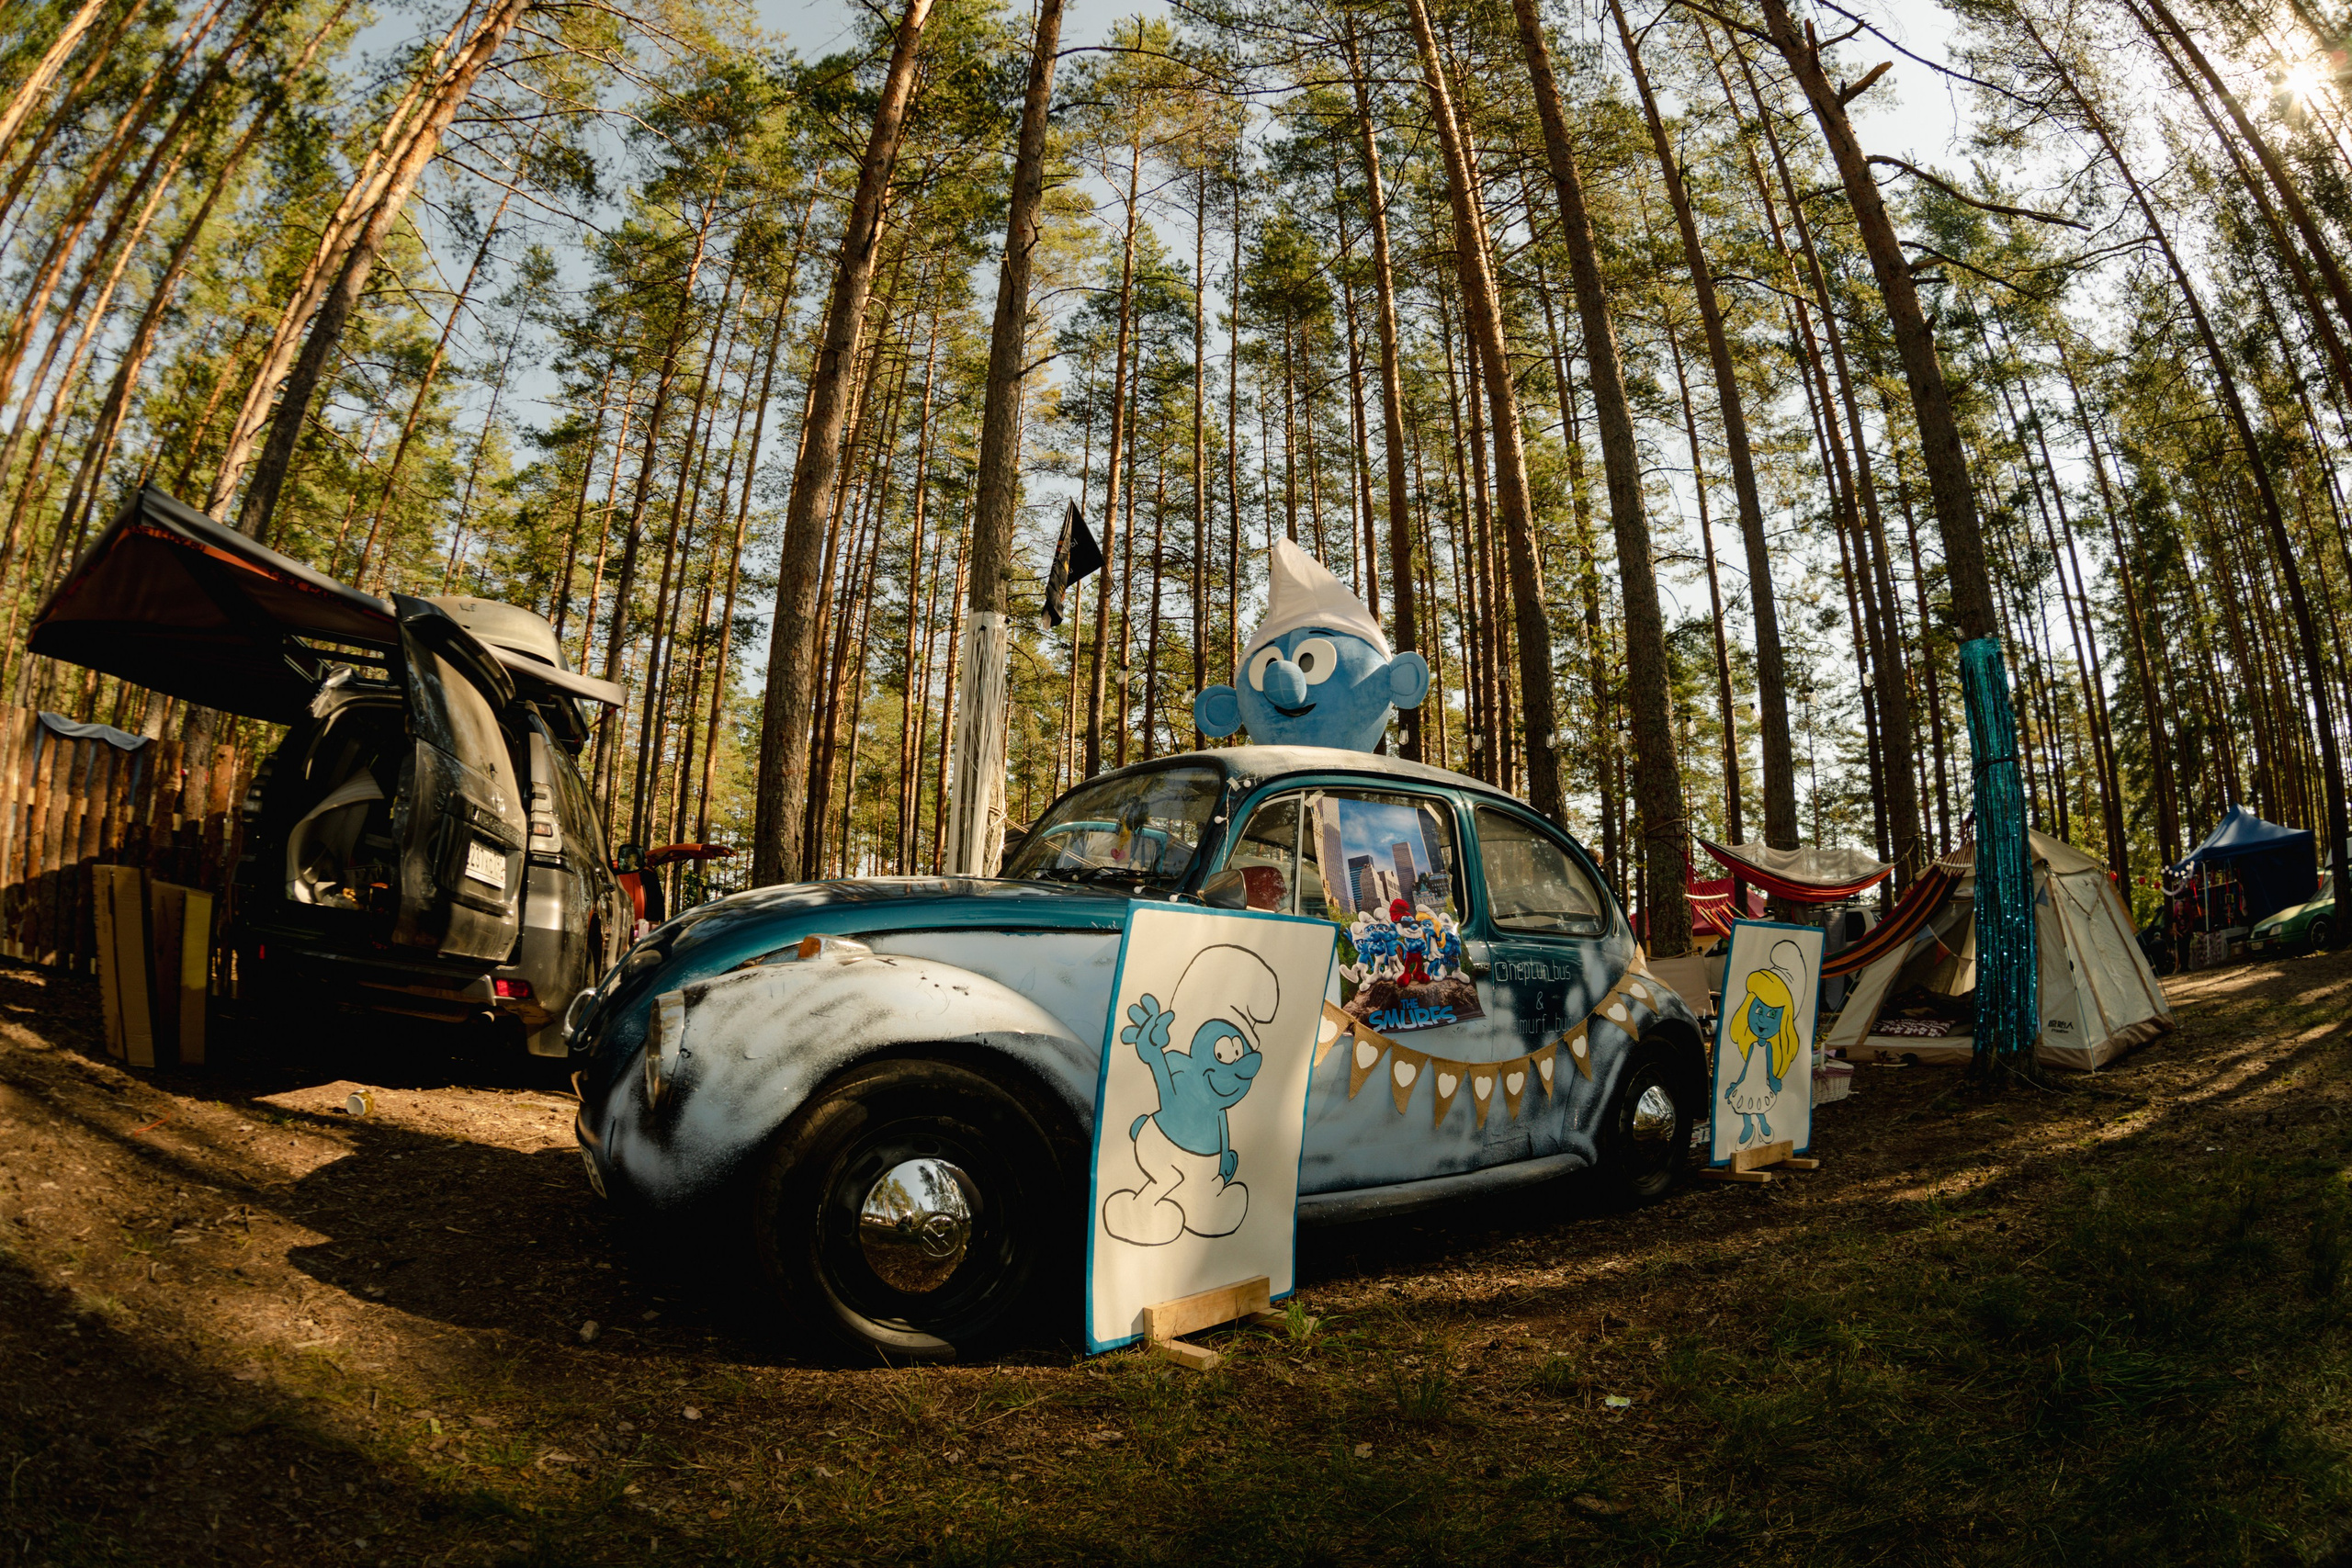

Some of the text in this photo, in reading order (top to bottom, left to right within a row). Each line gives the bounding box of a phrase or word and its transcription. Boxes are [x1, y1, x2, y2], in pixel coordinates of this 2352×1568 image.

[1400, 998, 1419, 1010] THE
[1536, 991, 1544, 1010] &
[1368, 1005, 1458, 1032] SMURFS
